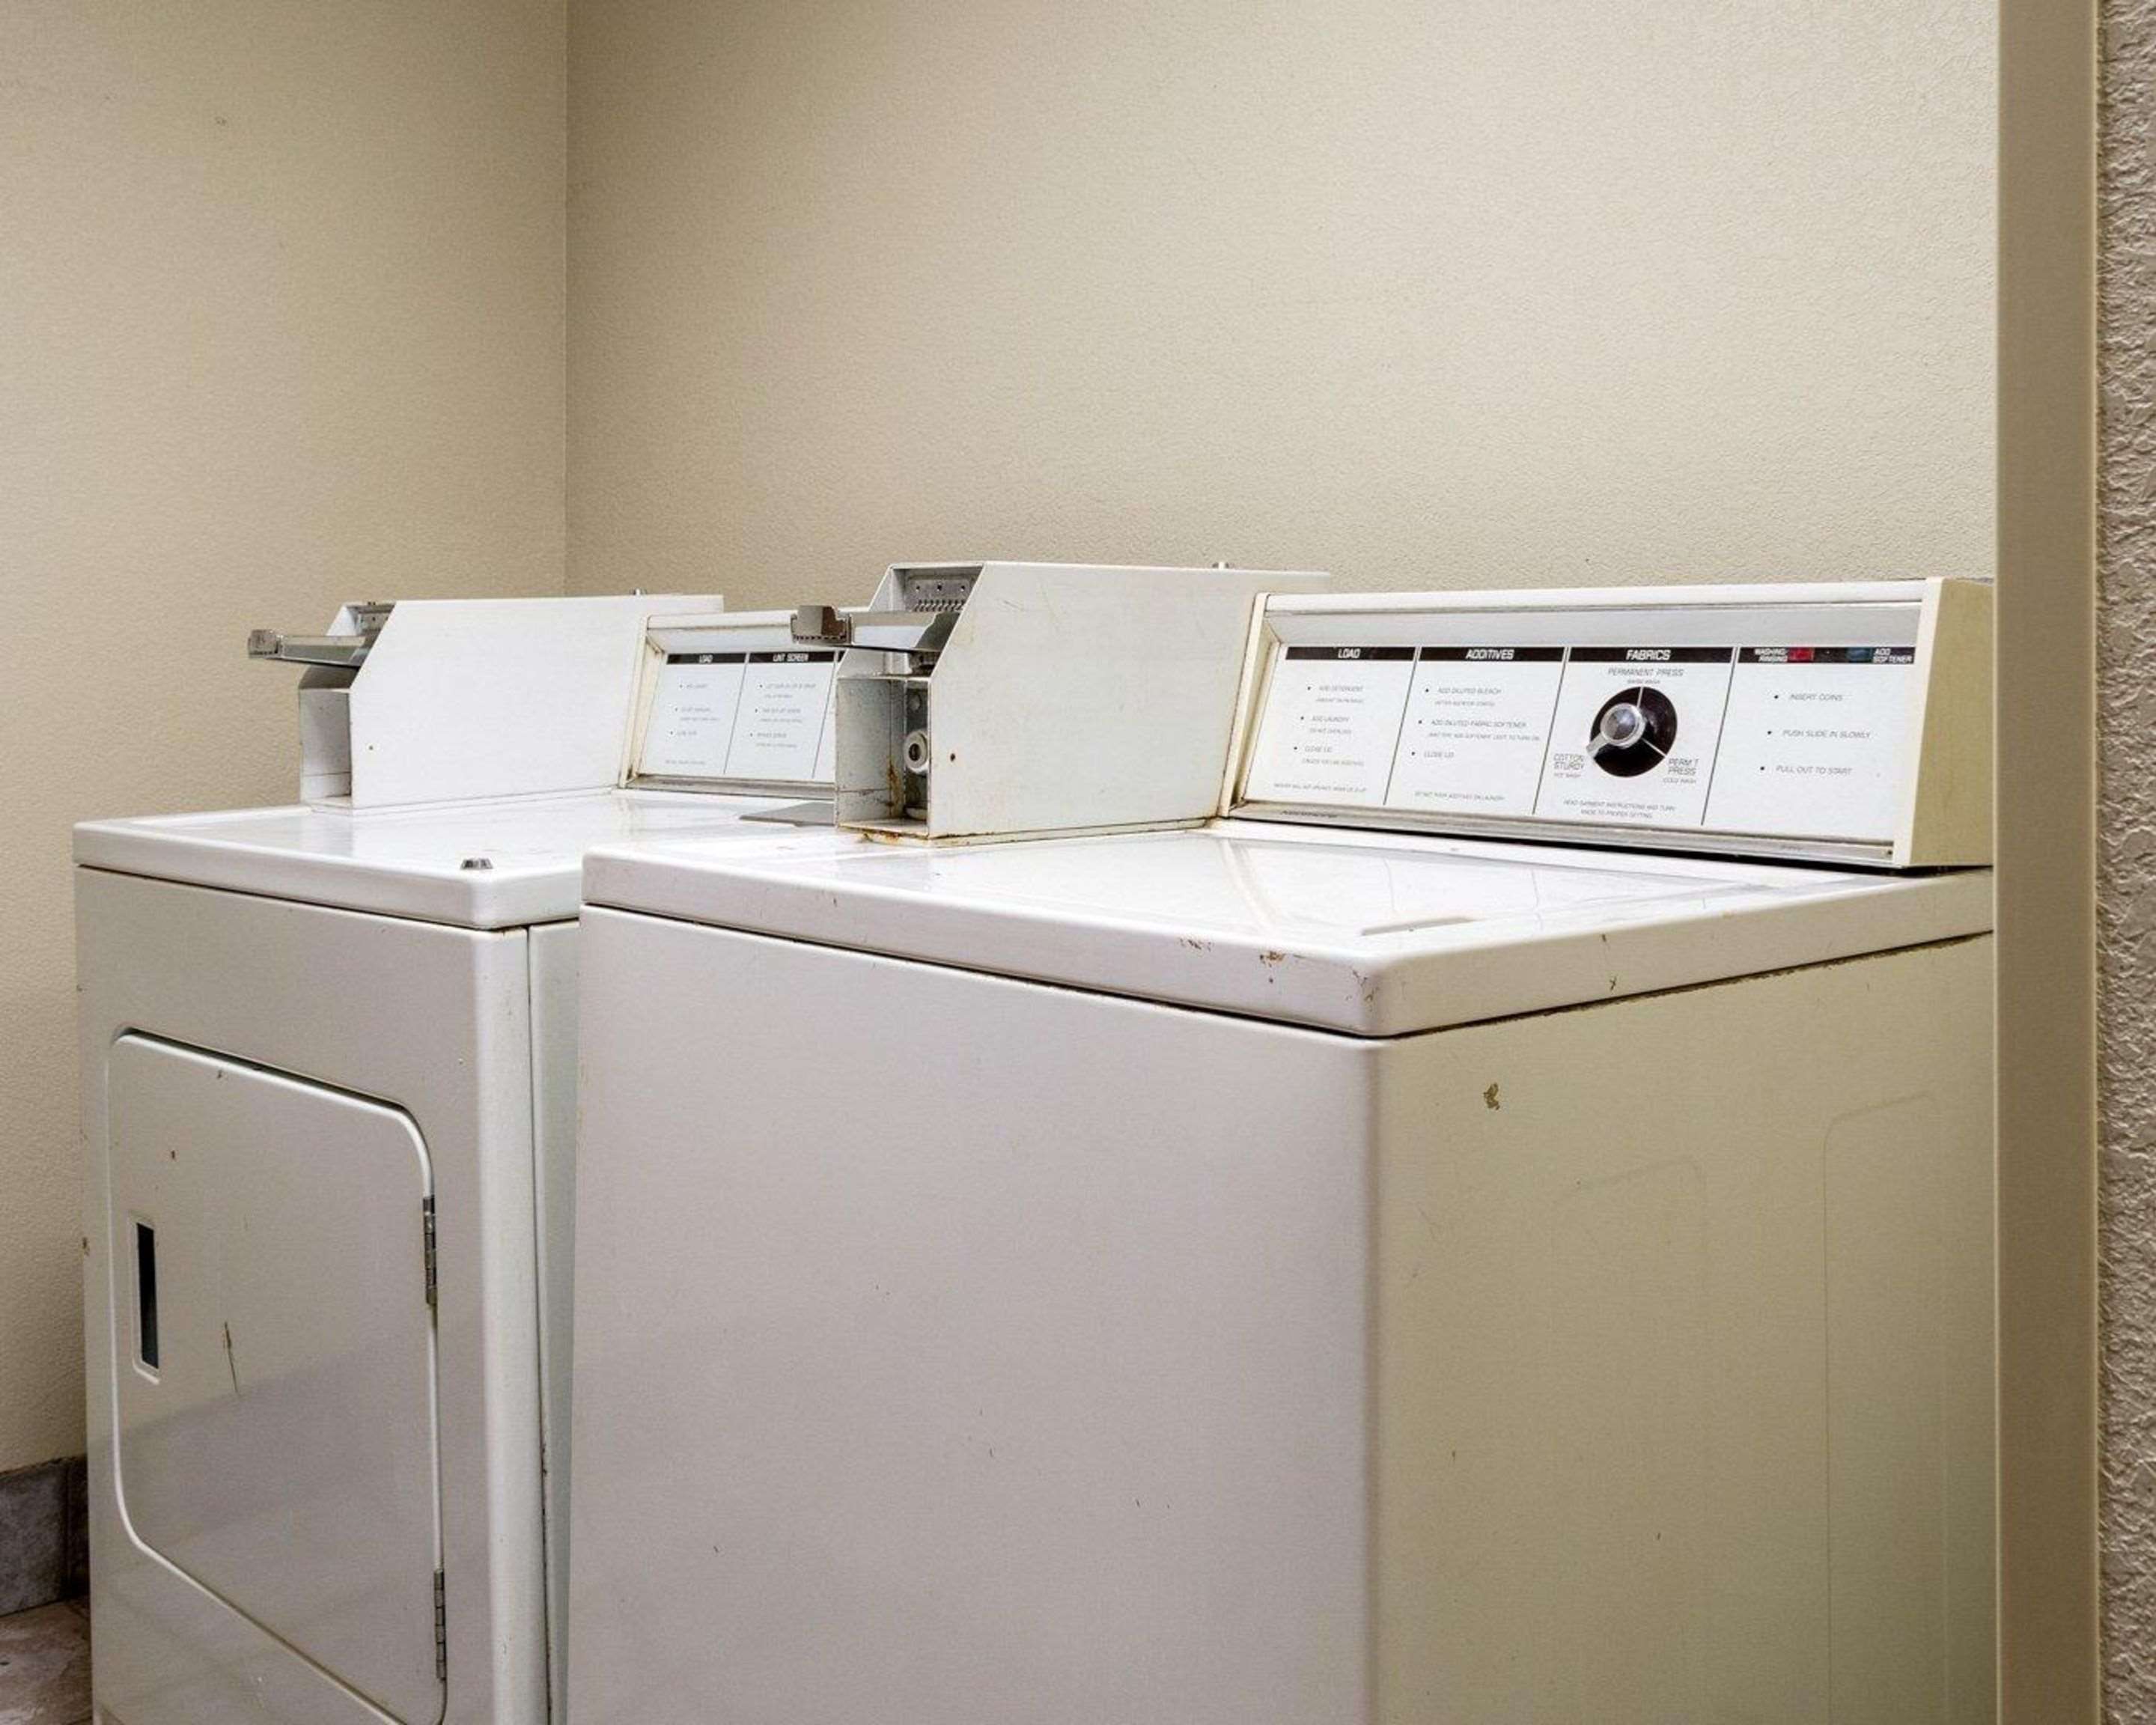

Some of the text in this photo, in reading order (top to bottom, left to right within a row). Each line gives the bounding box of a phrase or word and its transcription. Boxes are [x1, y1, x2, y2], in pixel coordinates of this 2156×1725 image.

[1338, 648, 1361, 658] LOAD
[1465, 648, 1515, 660] ADDITIVES
[1625, 648, 1671, 660] FABRICS
[1874, 648, 1892, 656] ADD
[1872, 655, 1913, 663] SOFTENER
[1608, 667, 1684, 677] PERMANENT PRESS
[1818, 693, 1843, 702] COINS
[1782, 729, 1871, 739] PUSH SLIDE IN SLOWLY
[1553, 761, 1585, 770] STURDY
[1776, 764, 1854, 776] PULL OUT TO START
[1668, 767, 1697, 776] PRESS
